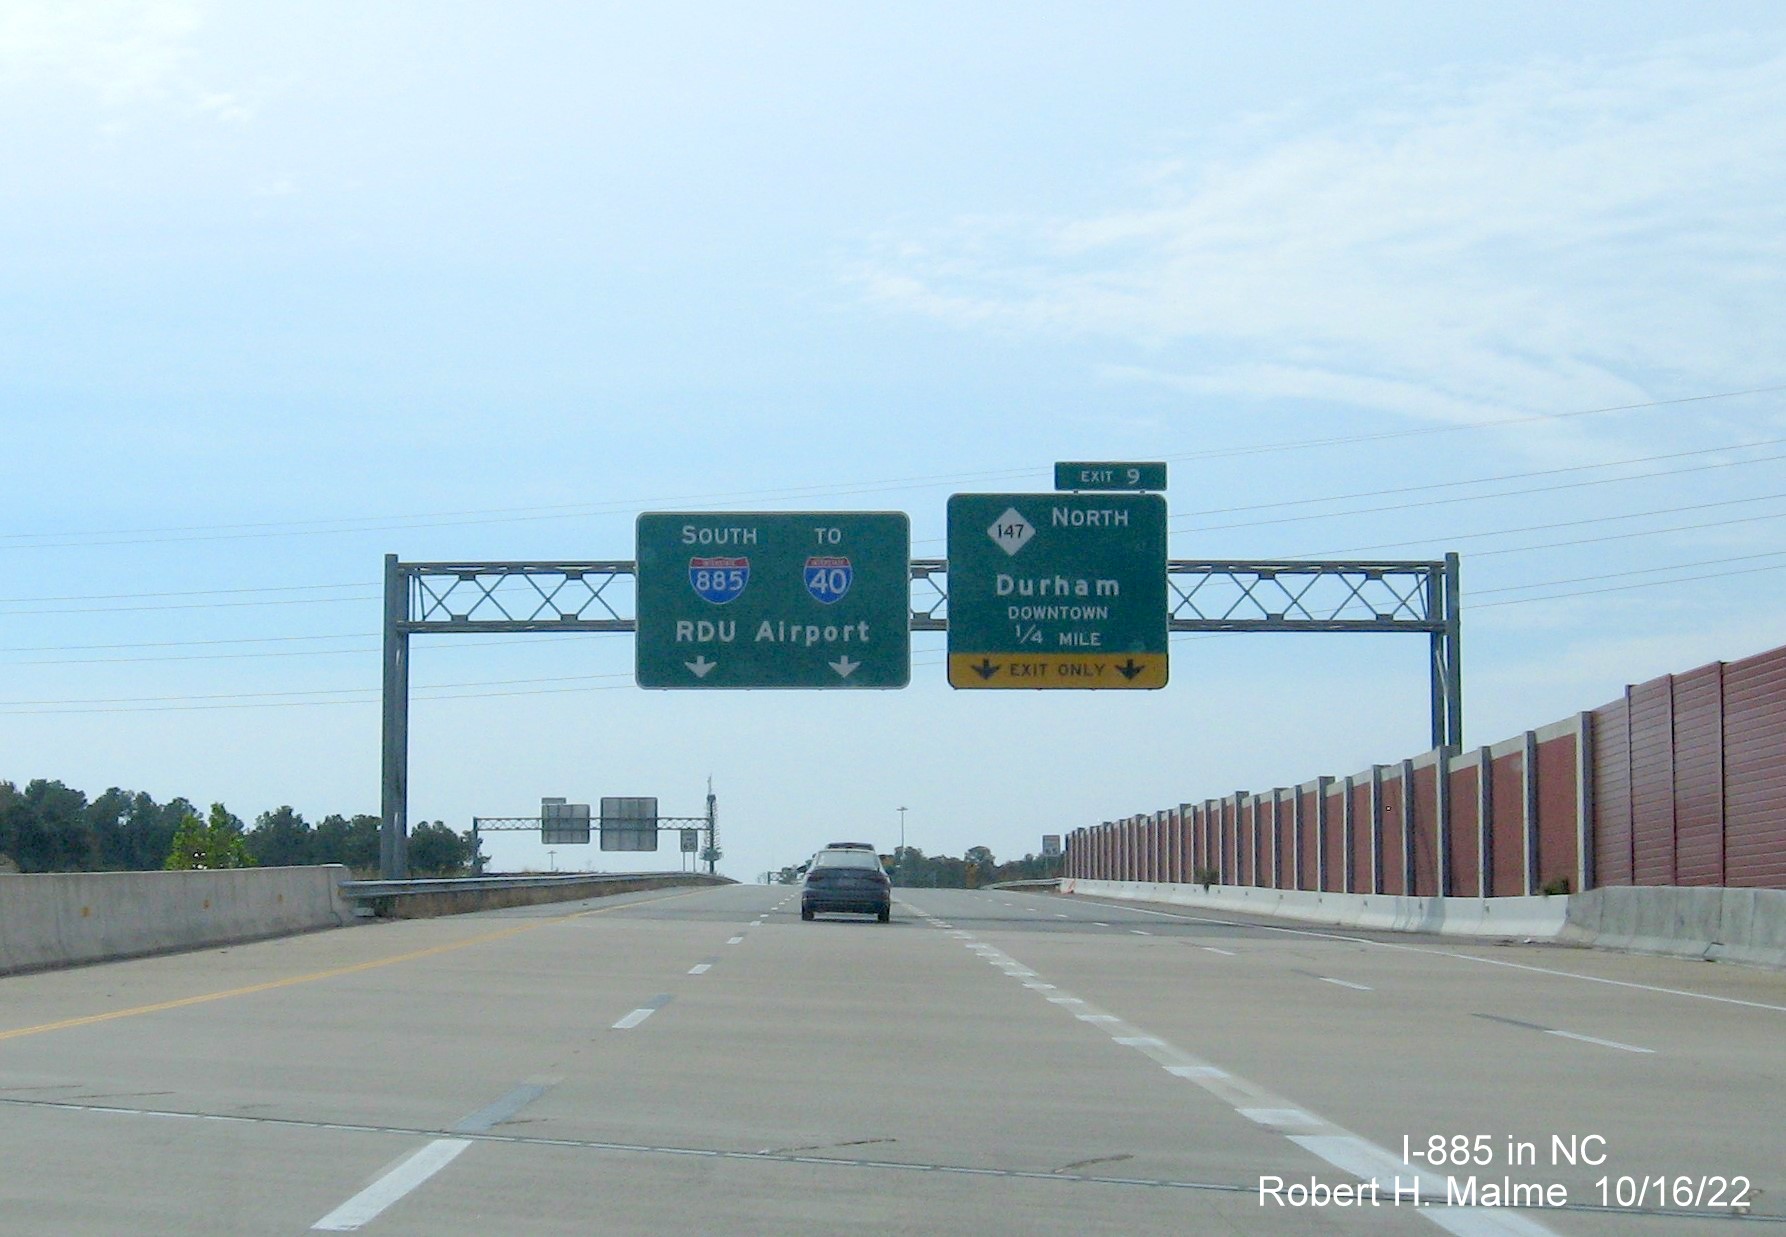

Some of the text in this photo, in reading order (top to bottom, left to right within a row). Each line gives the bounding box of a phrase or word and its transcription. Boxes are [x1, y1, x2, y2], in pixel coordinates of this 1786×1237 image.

[1081, 469, 1140, 484] EXIT 9
[1052, 507, 1128, 527] NORTH
[682, 525, 757, 544] SOUTH
[815, 528, 841, 544] TO
[997, 524, 1024, 538] 147
[696, 571, 743, 591] 885
[809, 569, 847, 594] 40
[996, 574, 1120, 596] Durham
[1008, 606, 1108, 620] DOWNTOWN
[676, 620, 870, 646] RDU Airport
[1059, 632, 1101, 646] MILE
[1010, 664, 1105, 676] EXIT ONLY
